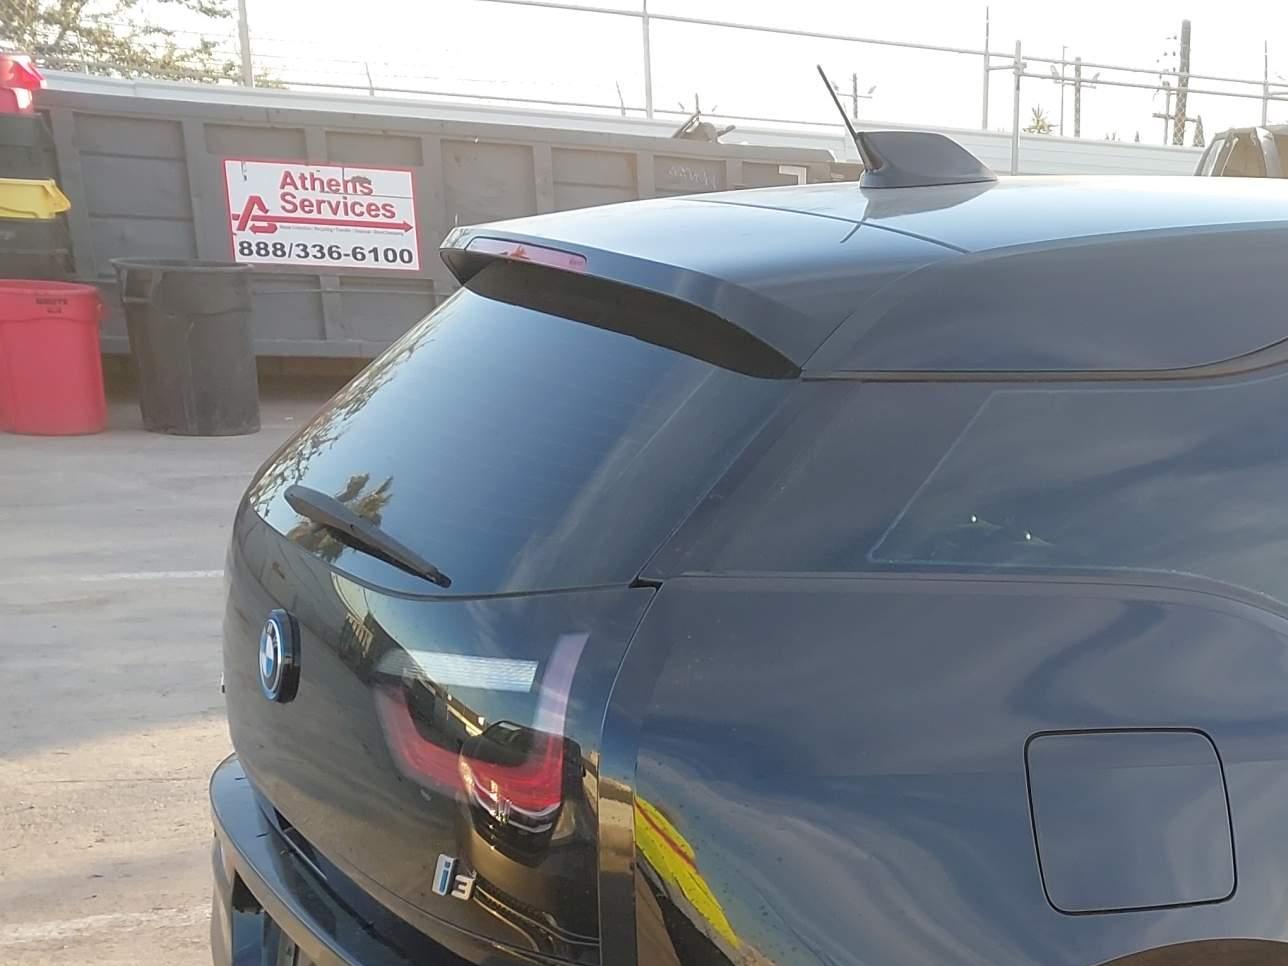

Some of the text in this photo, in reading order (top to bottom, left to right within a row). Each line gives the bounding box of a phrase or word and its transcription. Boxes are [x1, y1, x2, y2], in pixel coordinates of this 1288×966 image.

[280, 170, 374, 195] Athens
[280, 191, 396, 219] Services
[238, 240, 414, 264] 888/336-6100
[432, 854, 476, 900] i3
